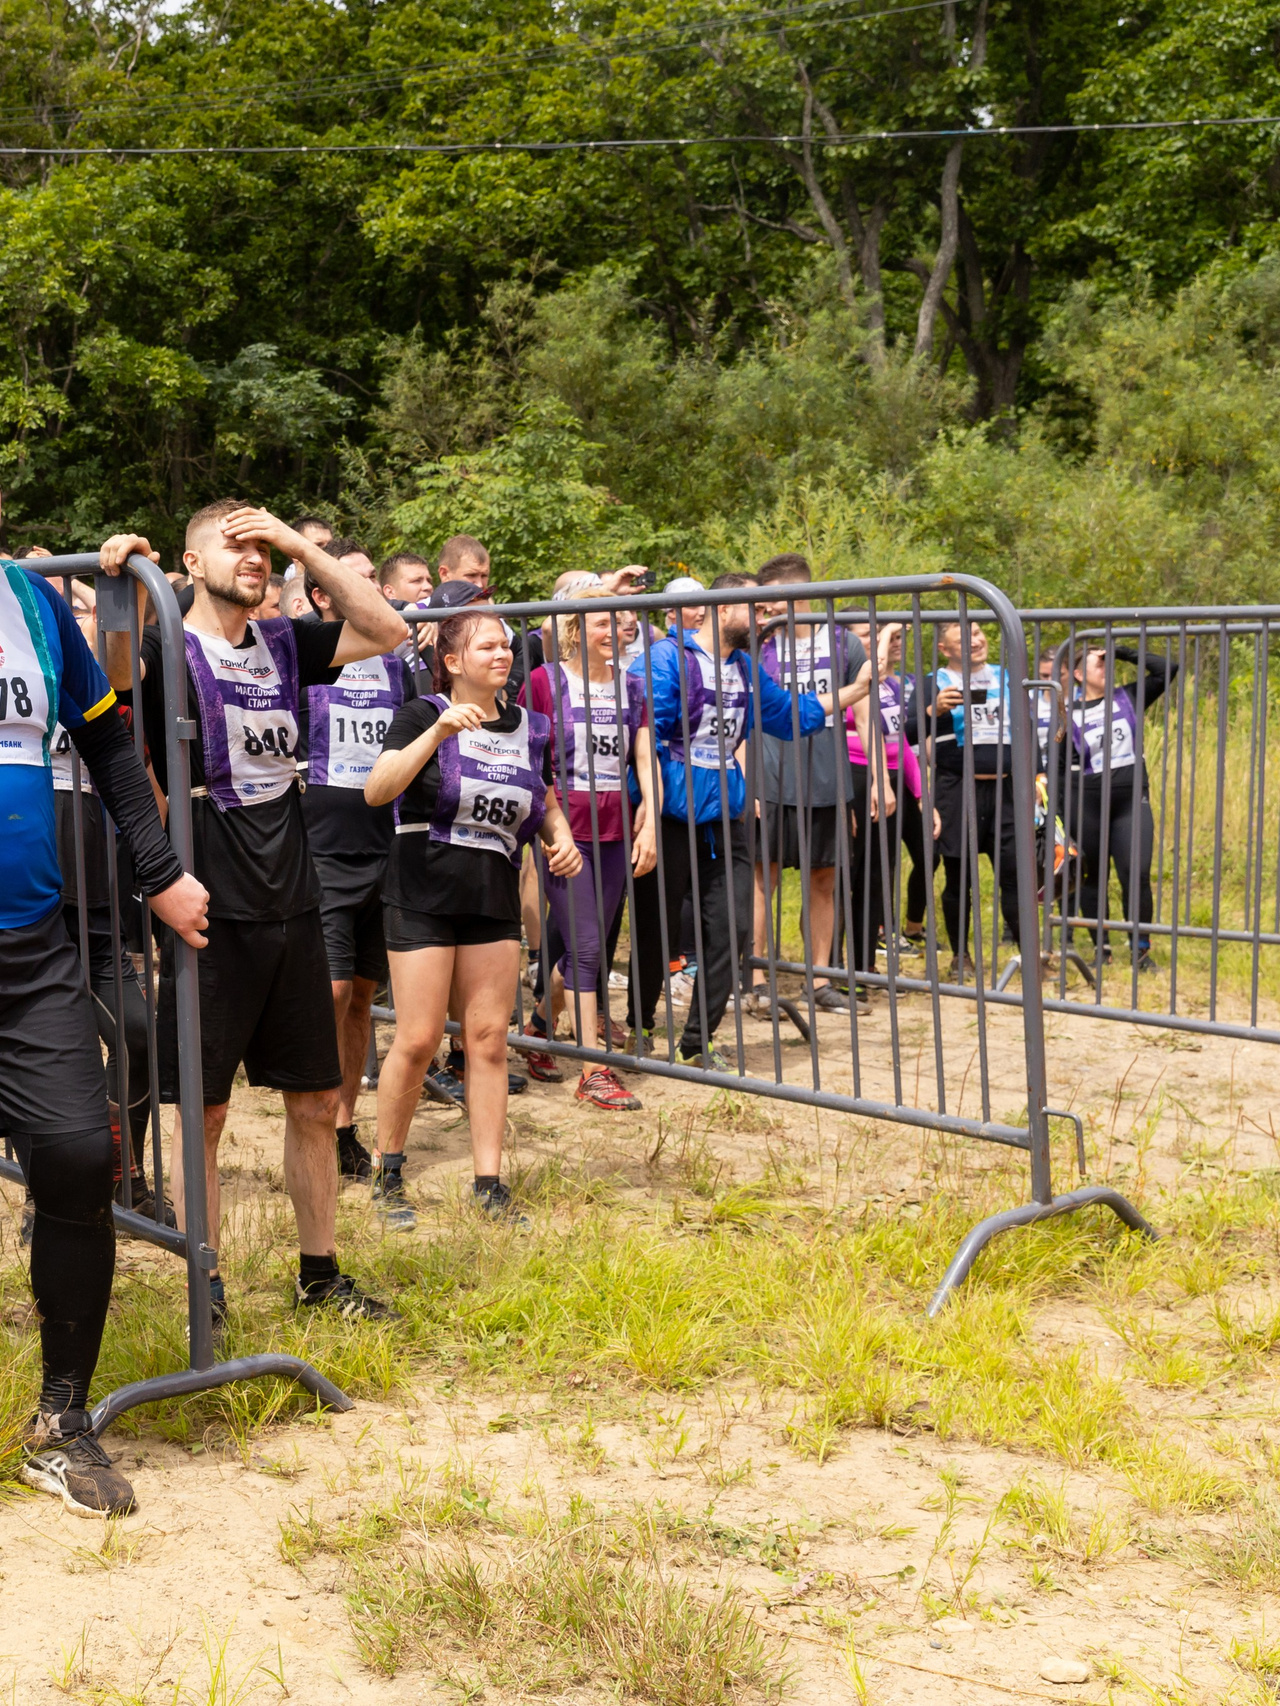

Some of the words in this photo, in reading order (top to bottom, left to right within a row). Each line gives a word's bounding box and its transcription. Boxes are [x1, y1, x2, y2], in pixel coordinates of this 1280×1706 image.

[343, 689, 378, 699] МАССОВЫЙ
[248, 698, 272, 708] СТАРТ
[351, 699, 370, 707] СТАРТ
[336, 717, 387, 745] 1138
[469, 740, 492, 753] ГОНКА
[493, 747, 520, 756] ГЕРОЕВ
[477, 763, 517, 776] МАССОВЫЙ
[488, 772, 510, 783] СТАРТ
[471, 794, 519, 827] 665
